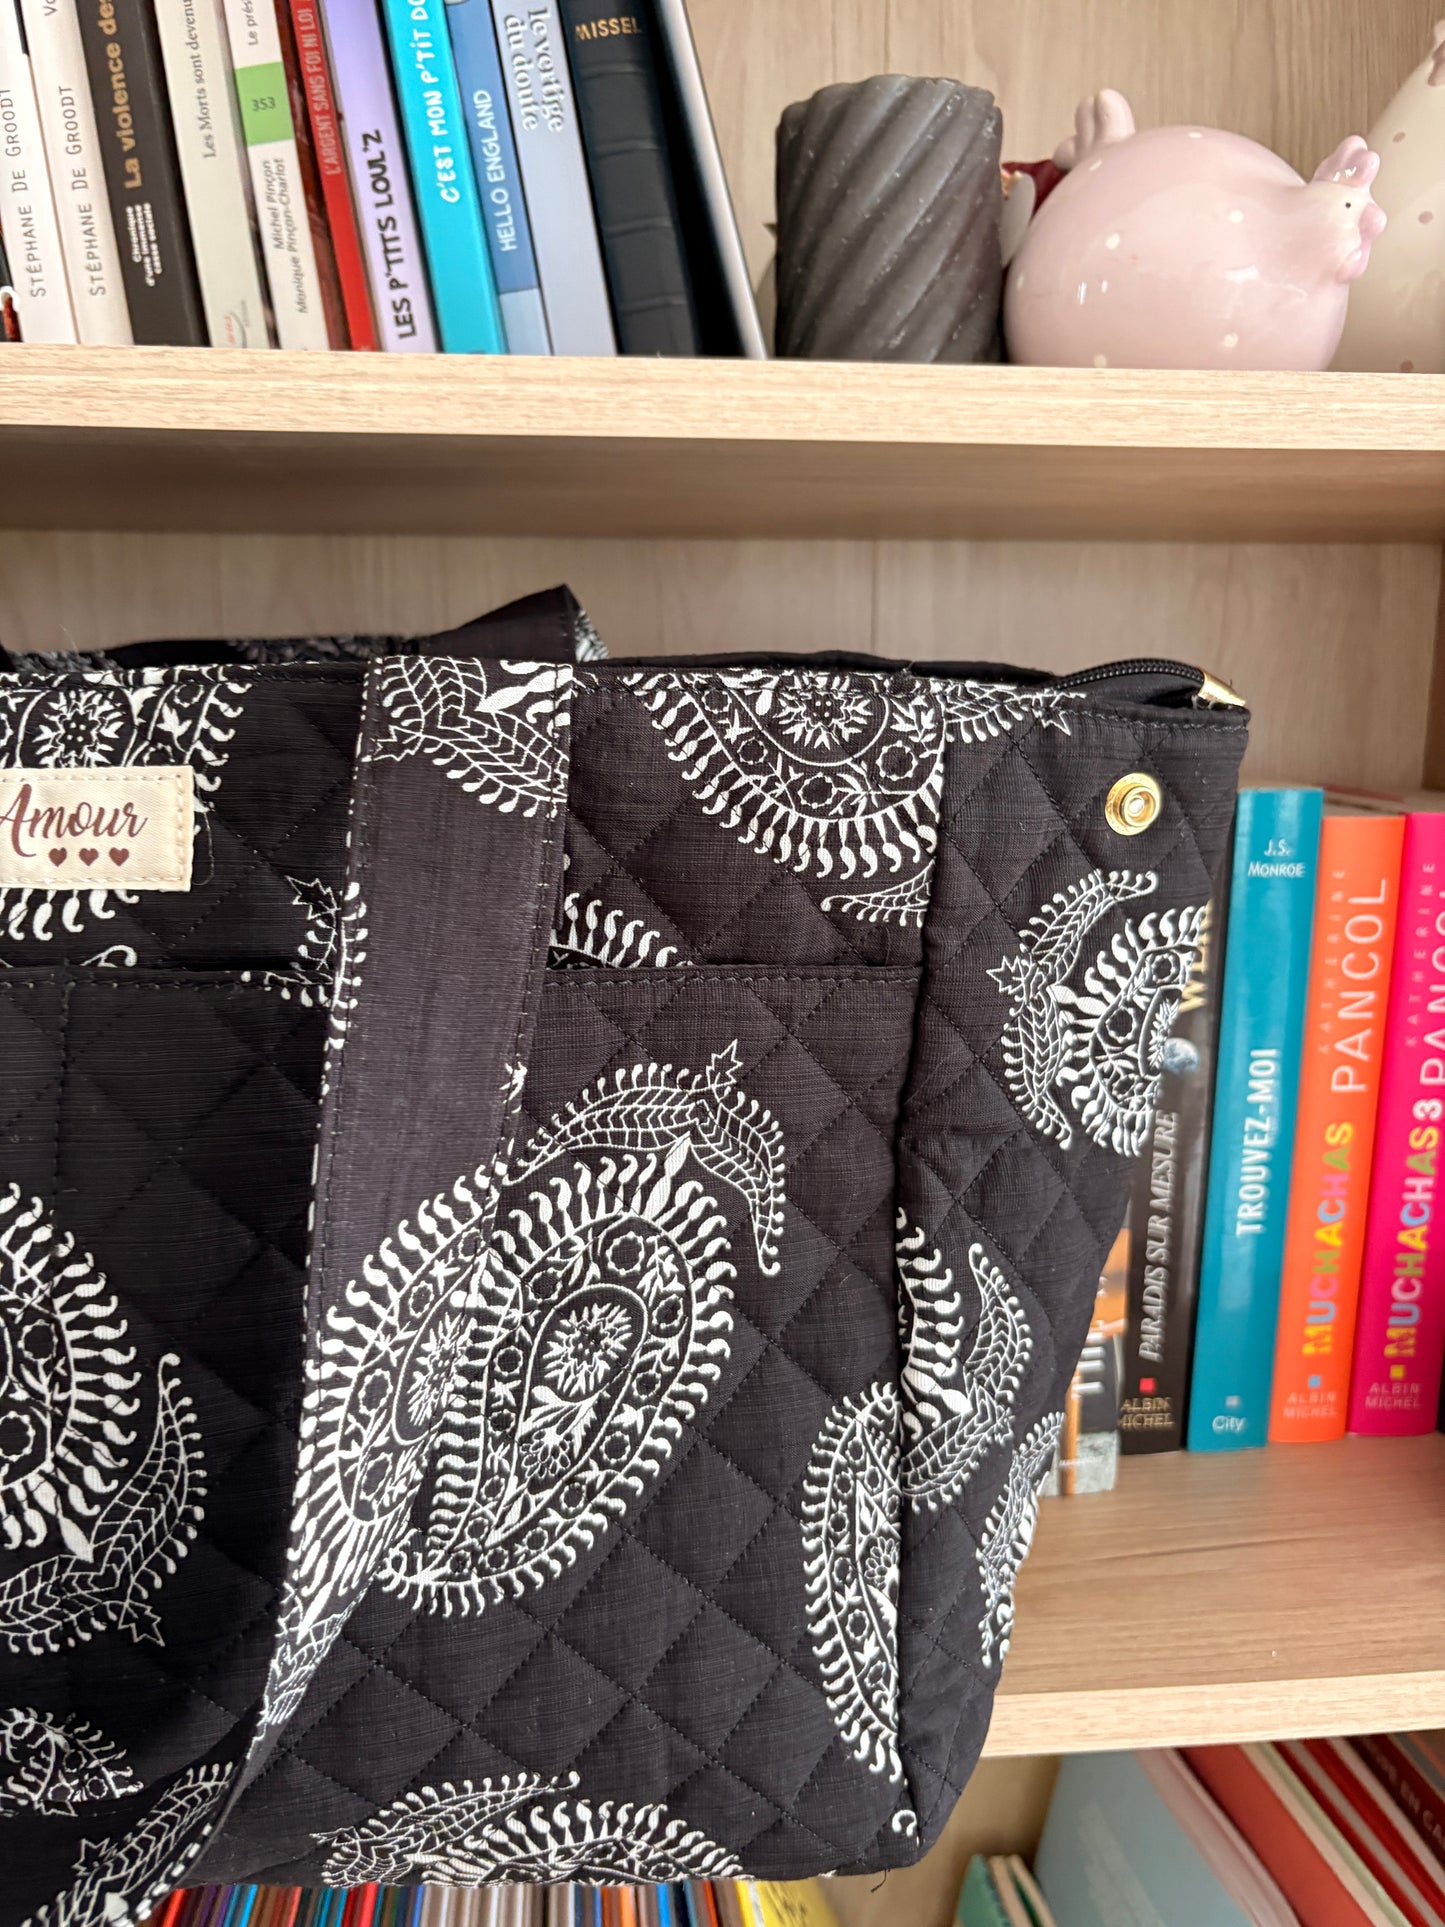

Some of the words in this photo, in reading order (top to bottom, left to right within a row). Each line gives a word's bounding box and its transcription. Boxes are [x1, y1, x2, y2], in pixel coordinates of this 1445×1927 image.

[97, 0, 118, 35] de
[248, 31, 260, 46] Le
[297, 7, 317, 31] LOI
[503, 14, 528, 50] du
[527, 8, 551, 36] le
[574, 16, 643, 41] MISSEL
[300, 32, 319, 48] NI
[304, 50, 324, 73] FOI
[190, 53, 206, 85] sont
[533, 36, 566, 133] vertige
[104, 42, 137, 151] violence
[196, 87, 213, 131] Morts
[251, 96, 277, 112] 353
[307, 74, 330, 111] SANS
[424, 89, 449, 136] MON
[511, 52, 540, 132] doute
[0, 88, 23, 157] GROODT
[58, 85, 83, 156] GROODT
[473, 89, 506, 184] ENGLAND
[199, 134, 217, 159] Les
[314, 114, 343, 177] L'ARGENT
[11, 168, 29, 193] DE
[72, 167, 90, 192] DE
[124, 156, 143, 190] La
[262, 159, 279, 204] Pinçon
[361, 128, 393, 209] LOUL'Z
[433, 144, 461, 204] C'EST
[143, 202, 157, 241] sociale
[274, 157, 300, 254] Pinçon-Charlot
[490, 186, 518, 252] HELLO
[73, 202, 107, 297] STÉPHANE
[126, 205, 142, 263] Chronique
[134, 203, 150, 255] immense
[267, 206, 286, 250] Michel
[19, 204, 46, 298] STÉPHANE
[143, 256, 156, 287] d'une
[150, 242, 162, 275] casse
[377, 214, 409, 291] P'TITS
[289, 255, 309, 314] Monique
[391, 296, 418, 340] LES
[0, 783, 149, 858] Amour
[1263, 838, 1294, 857] J.S.
[1247, 862, 1306, 879] MONROE
[1317, 869, 1346, 1056] KATHERINE
[1404, 862, 1436, 1048] KATHERINE
[1330, 876, 1387, 1094] PANCOL
[1149, 1110, 1180, 1212] MESURE
[1234, 1048, 1279, 1237] TROUVEZ-MOI
[1146, 1213, 1174, 1264] SUR
[1302, 1121, 1355, 1358] MUCHACHAS
[1384, 1126, 1440, 1359] MUCHACHAS
[1412, 1097, 1445, 1122] 3
[1138, 1265, 1170, 1364] PARADIS
[1121, 1397, 1173, 1412] ALBIN
[1287, 1391, 1337, 1405] ALBIN
[1364, 1393, 1421, 1410] MICHEL
[1369, 1381, 1420, 1395] ALBIN
[1211, 1414, 1246, 1434] City
[1283, 1403, 1338, 1419] MICHEL
